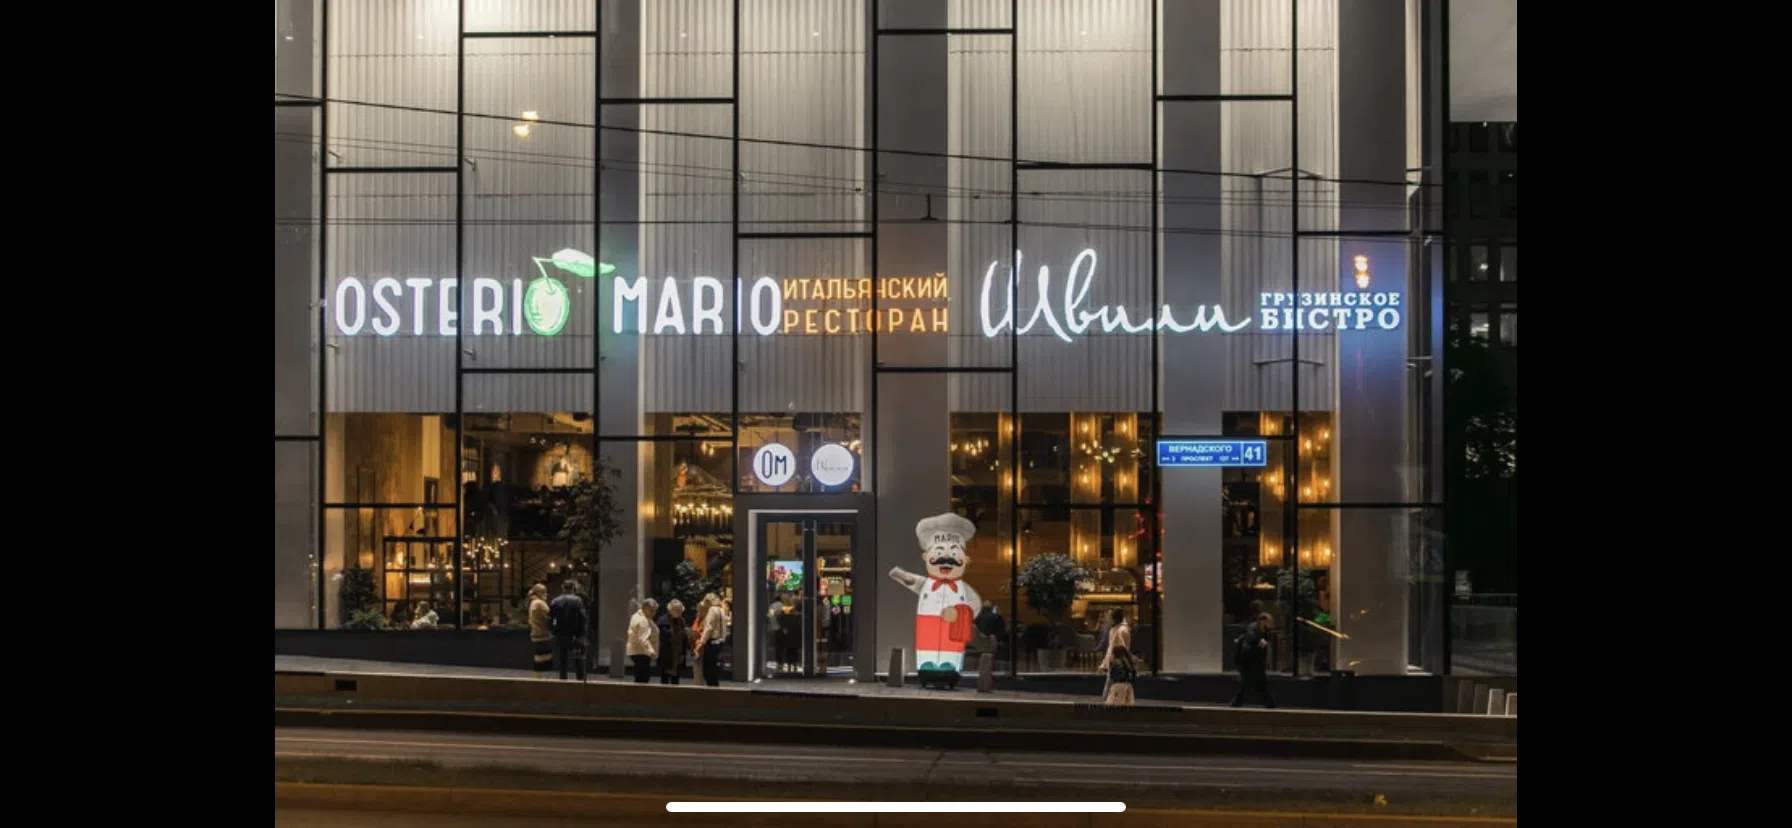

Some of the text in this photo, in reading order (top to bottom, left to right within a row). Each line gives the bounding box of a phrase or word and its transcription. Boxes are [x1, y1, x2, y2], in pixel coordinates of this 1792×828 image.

[783, 272, 948, 301] ИТАЛЬЯНСКИЙ
[612, 275, 782, 337] MARIO
[783, 308, 949, 334] РЕСТОРАН
[1260, 308, 1401, 330] БИСТРО
[1168, 444, 1233, 454] ВЕРНАДСКОГО
[1244, 445, 1262, 461] 41
